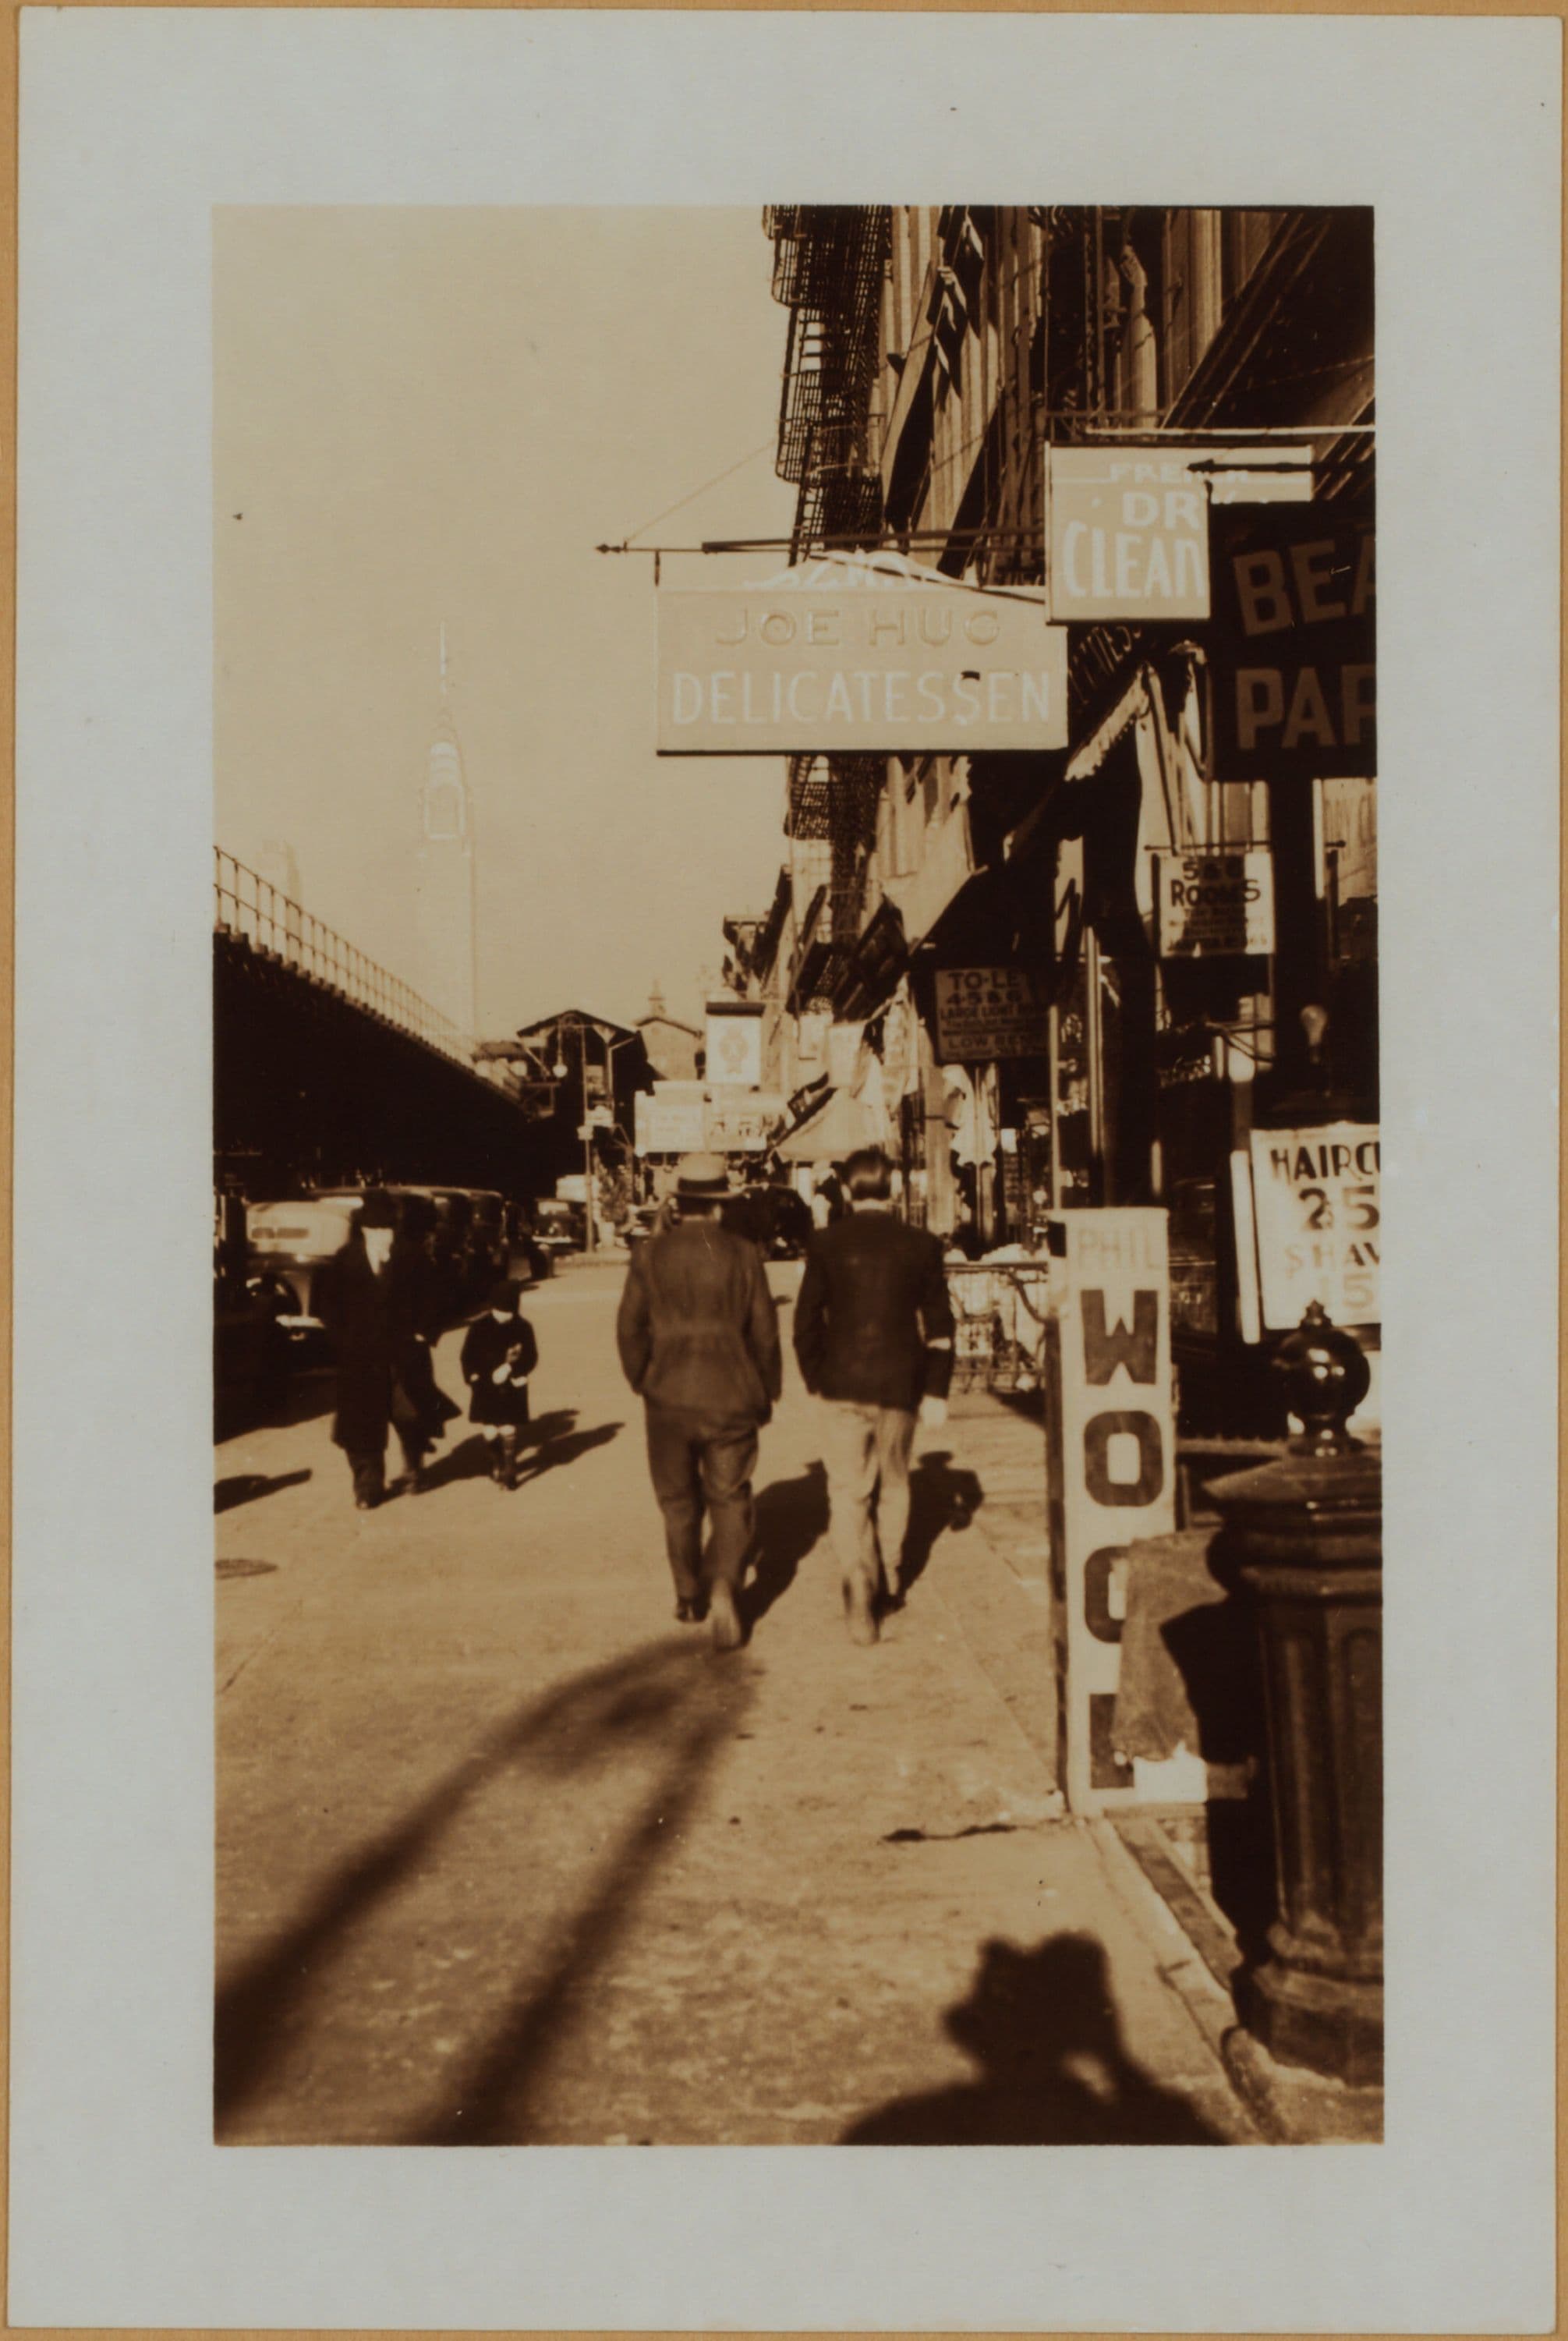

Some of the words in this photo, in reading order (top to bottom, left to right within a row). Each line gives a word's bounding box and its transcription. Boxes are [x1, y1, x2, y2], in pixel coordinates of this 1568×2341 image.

[715, 608, 841, 647] JOE
[671, 669, 1051, 727] DELICATESSEN
[1297, 1184, 1380, 1232] 25
